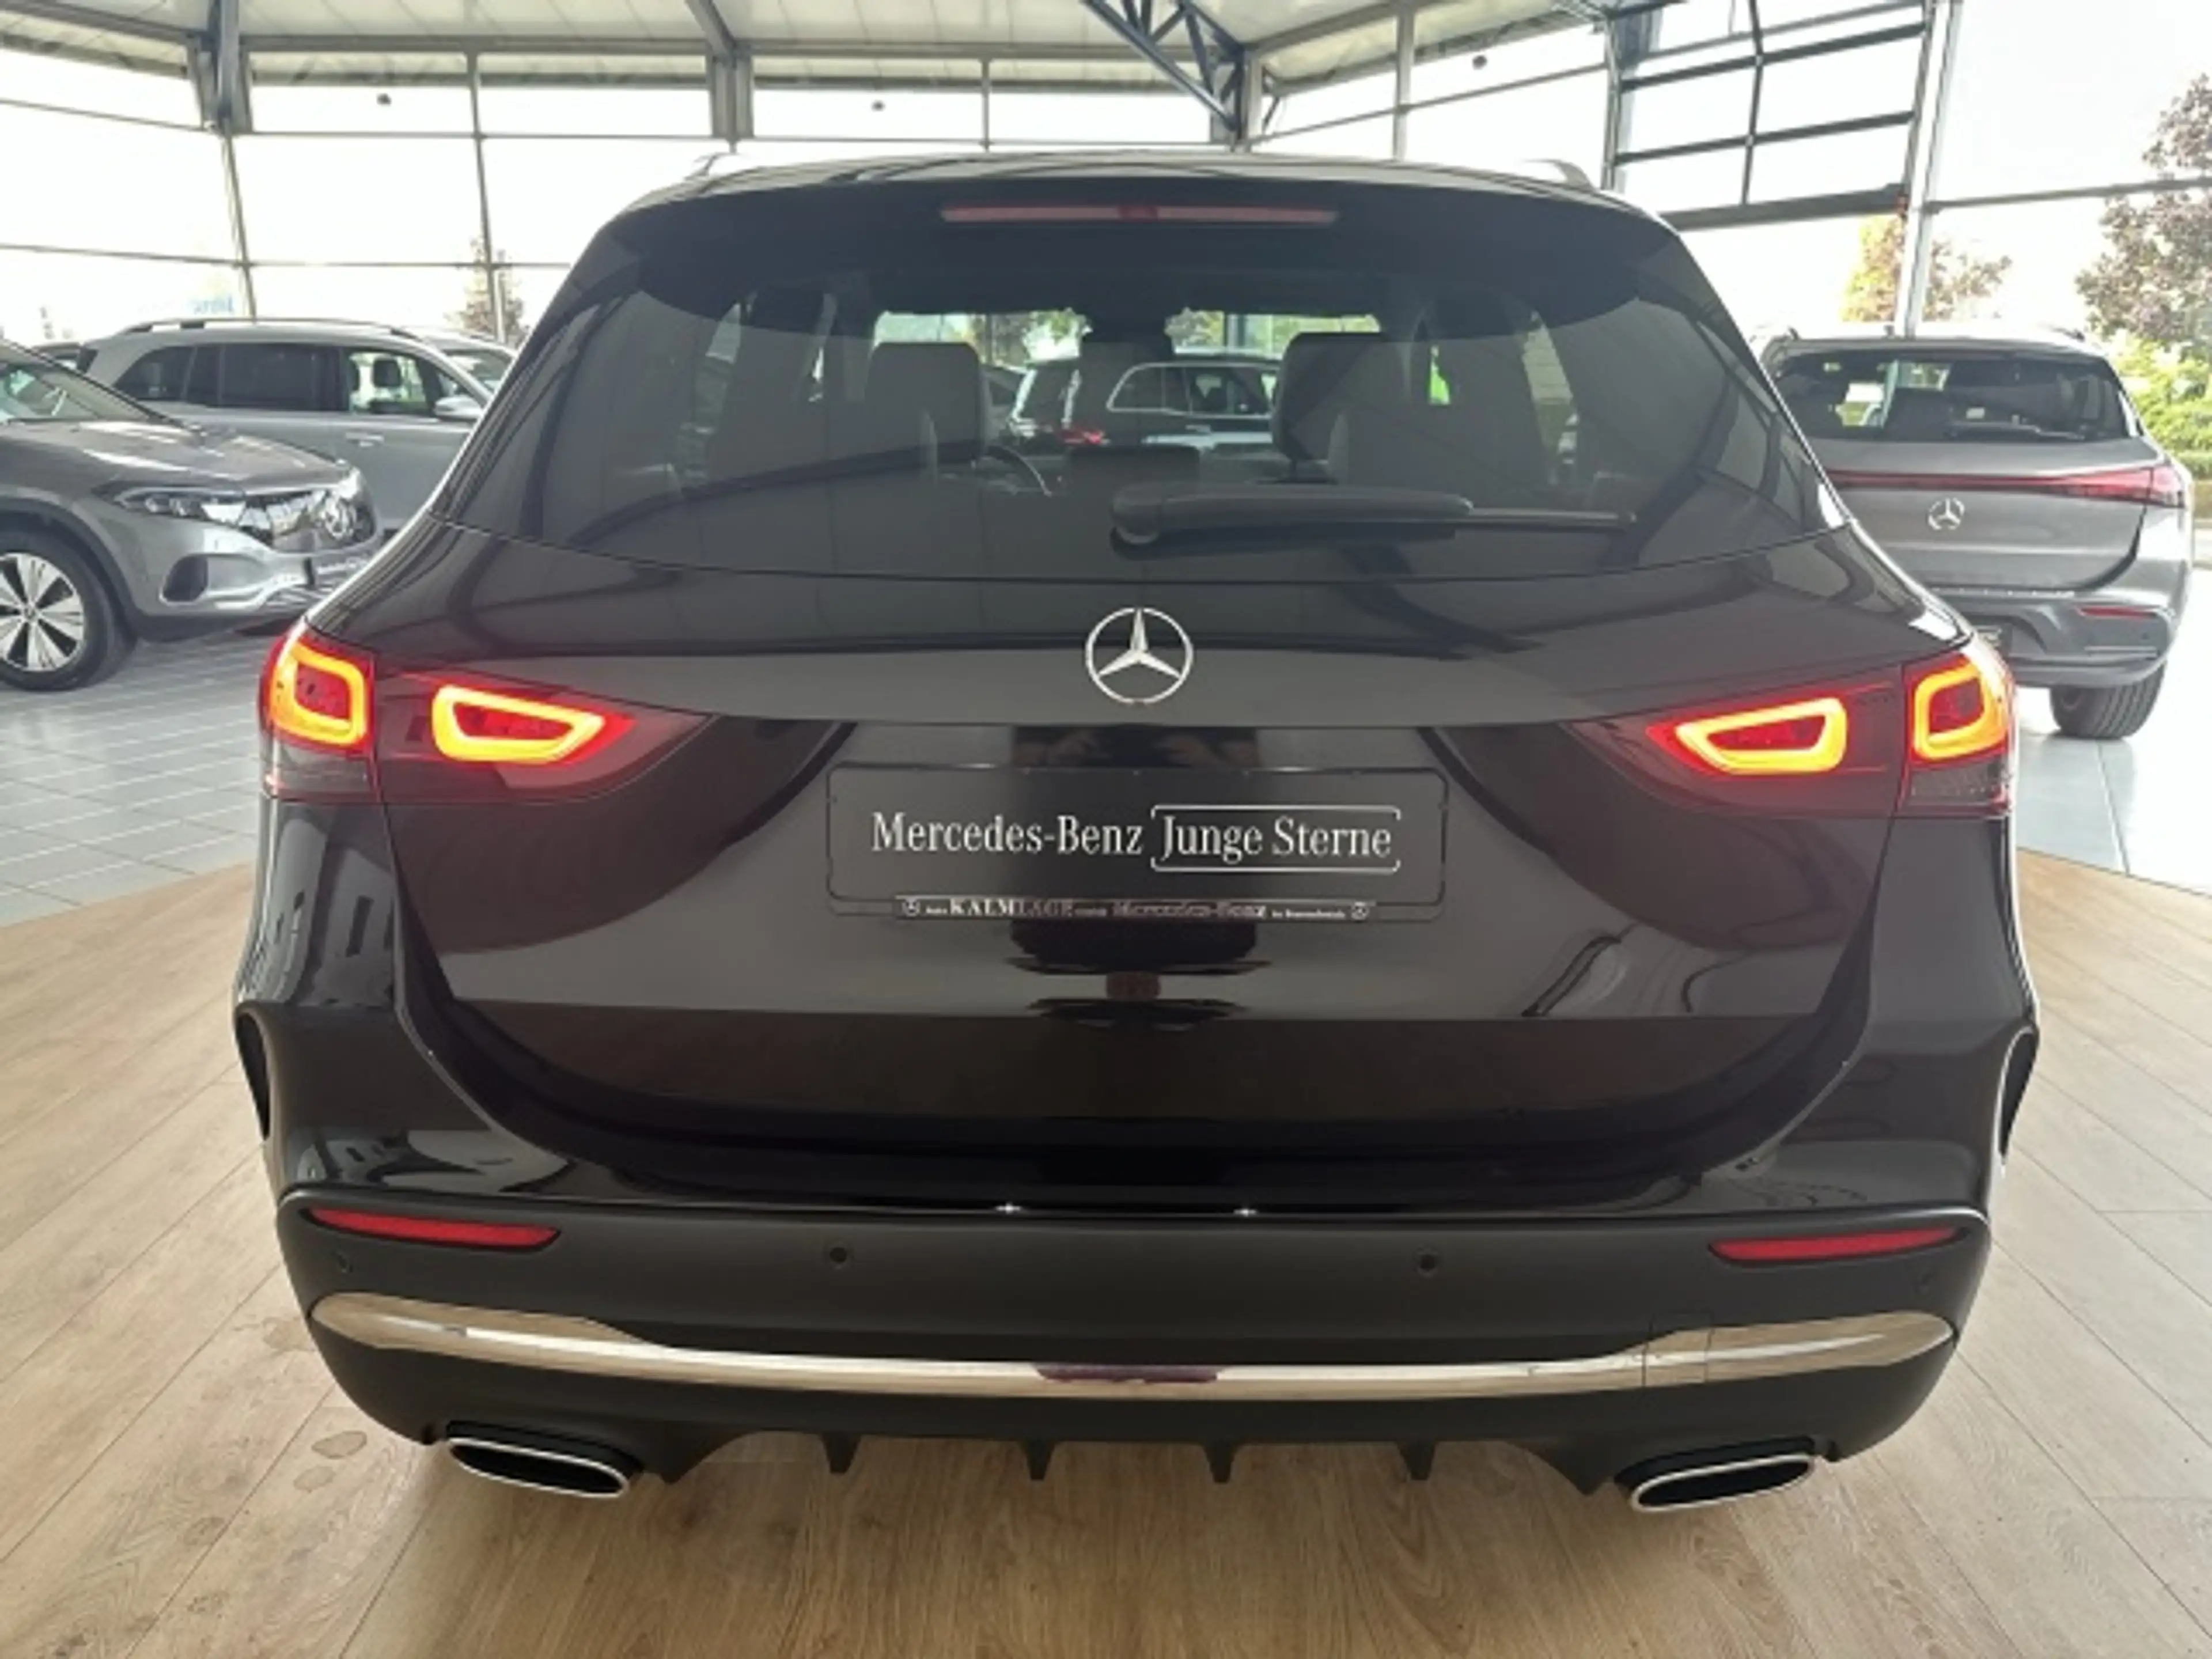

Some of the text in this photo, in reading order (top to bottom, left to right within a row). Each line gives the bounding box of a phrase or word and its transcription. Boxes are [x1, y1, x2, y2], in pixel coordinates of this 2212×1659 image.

[872, 811, 1391, 864] Mercedes-Benz Junge Sterne
